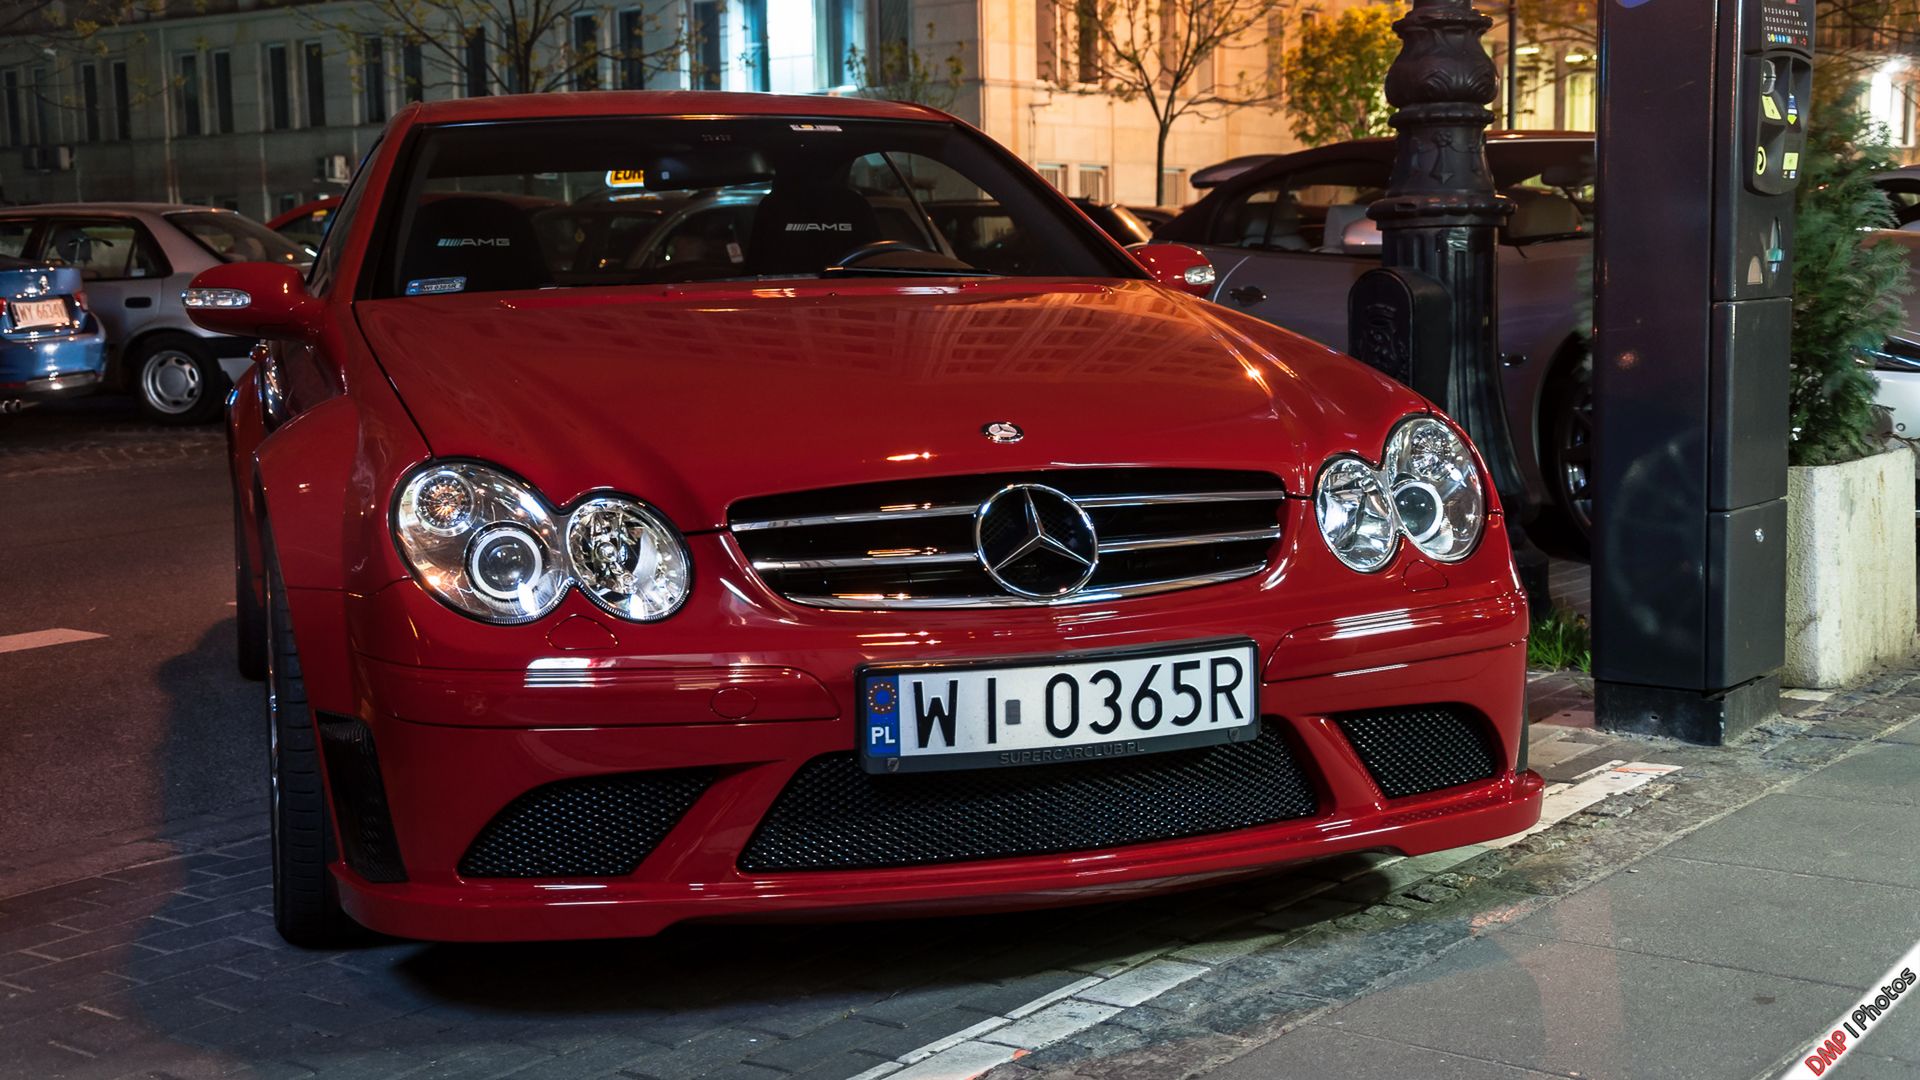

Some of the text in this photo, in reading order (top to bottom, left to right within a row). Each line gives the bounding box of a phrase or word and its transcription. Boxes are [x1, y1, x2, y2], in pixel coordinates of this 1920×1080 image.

[912, 655, 1244, 748] WI 0365R
[871, 726, 895, 745] PL
